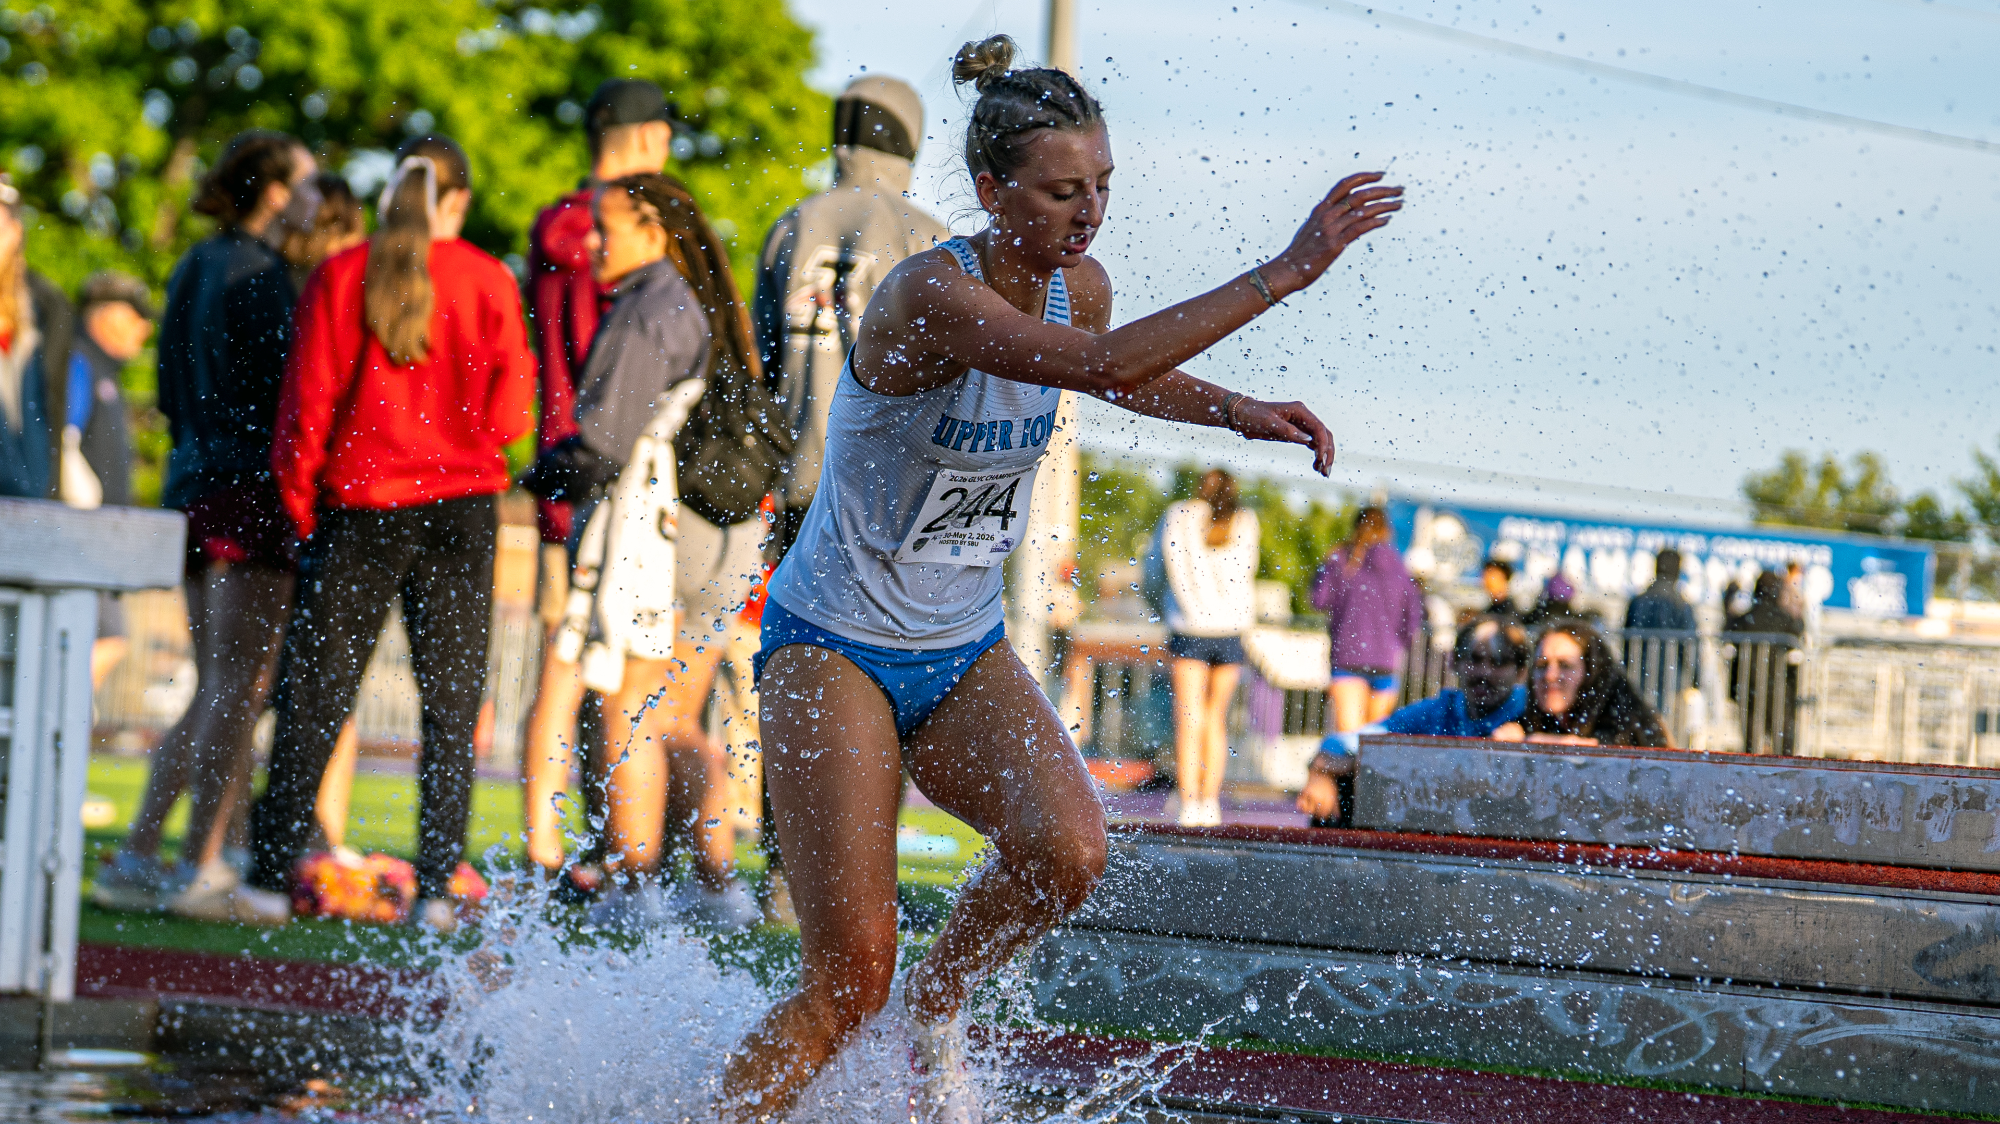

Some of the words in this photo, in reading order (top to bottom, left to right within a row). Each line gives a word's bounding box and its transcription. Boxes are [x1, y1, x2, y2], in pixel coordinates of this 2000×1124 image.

[932, 413, 1014, 453] UPPER
[949, 475, 967, 483] 2026
[920, 477, 1021, 534] 244
[976, 533, 995, 541] 2026
